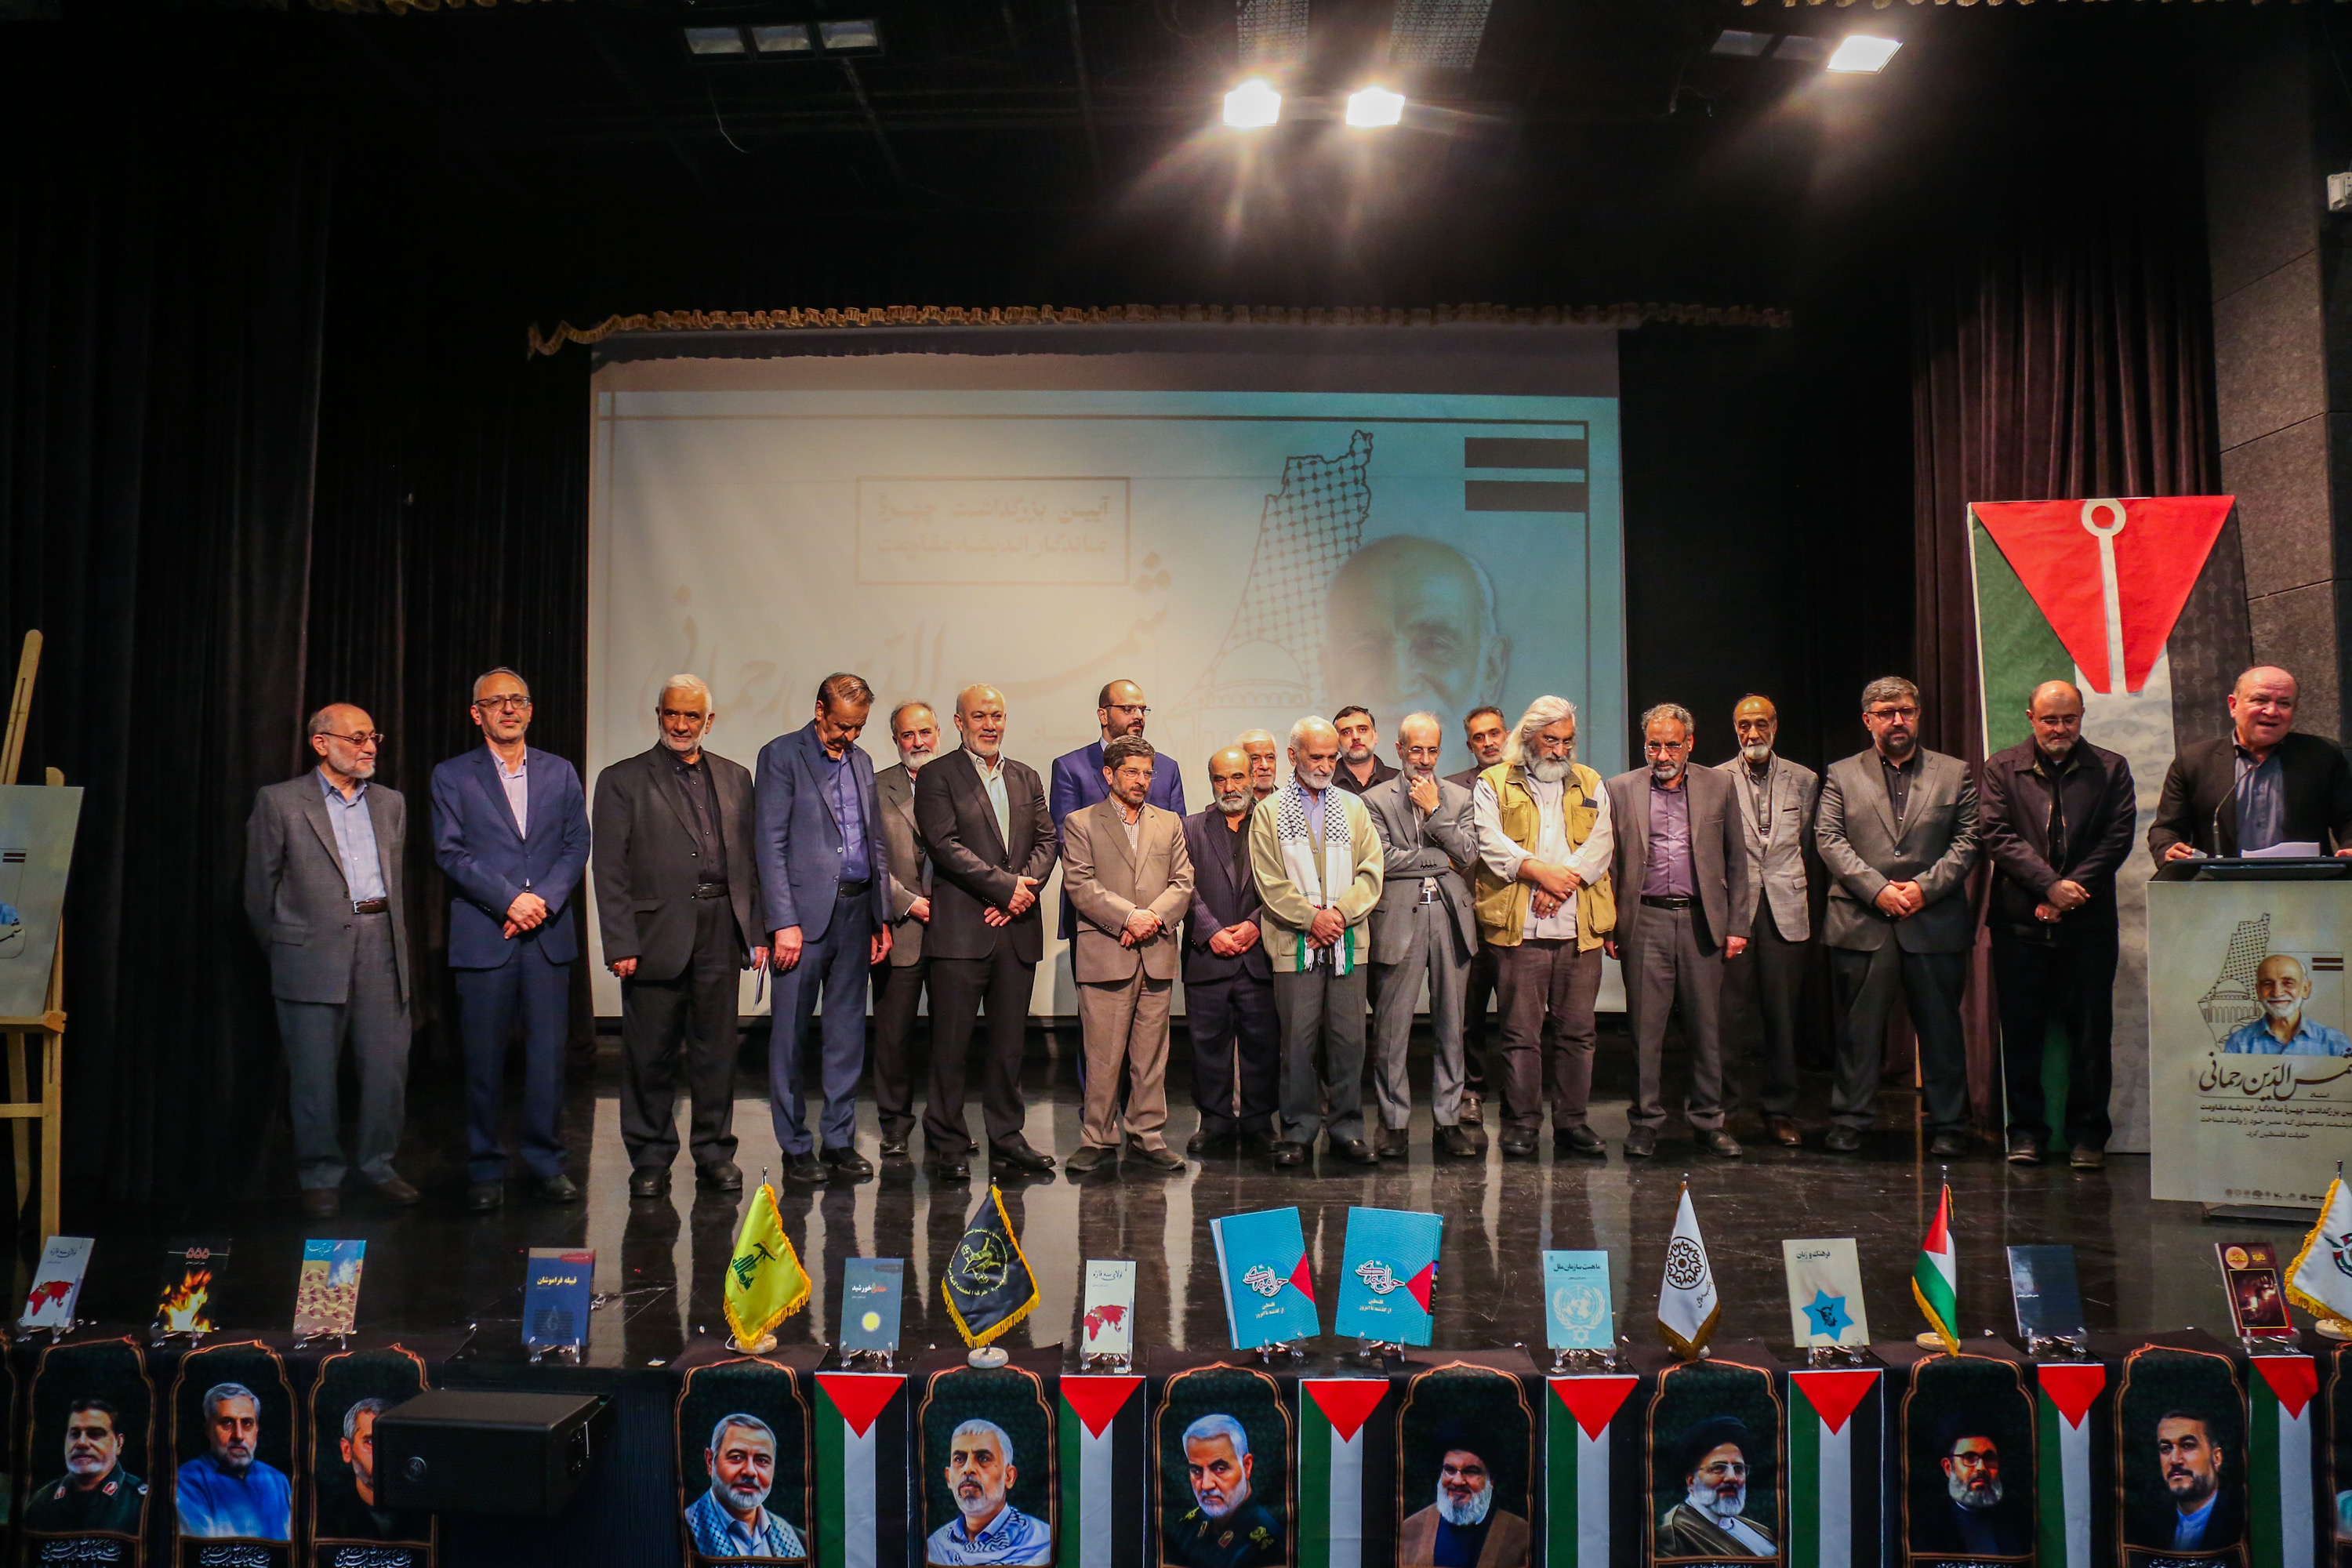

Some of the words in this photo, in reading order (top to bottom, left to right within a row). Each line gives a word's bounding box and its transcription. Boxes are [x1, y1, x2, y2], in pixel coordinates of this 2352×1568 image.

[951, 495, 1047, 523] بزرگداشت
[877, 534, 953, 559] مقاومت
[1029, 533, 1108, 558] ماندگار
[2199, 1051, 2243, 1091] رحمانی
[186, 1247, 209, 1259] ۵۵۵
[1564, 1263, 1582, 1272] سازمان
[851, 1285, 873, 1294] خورشید
